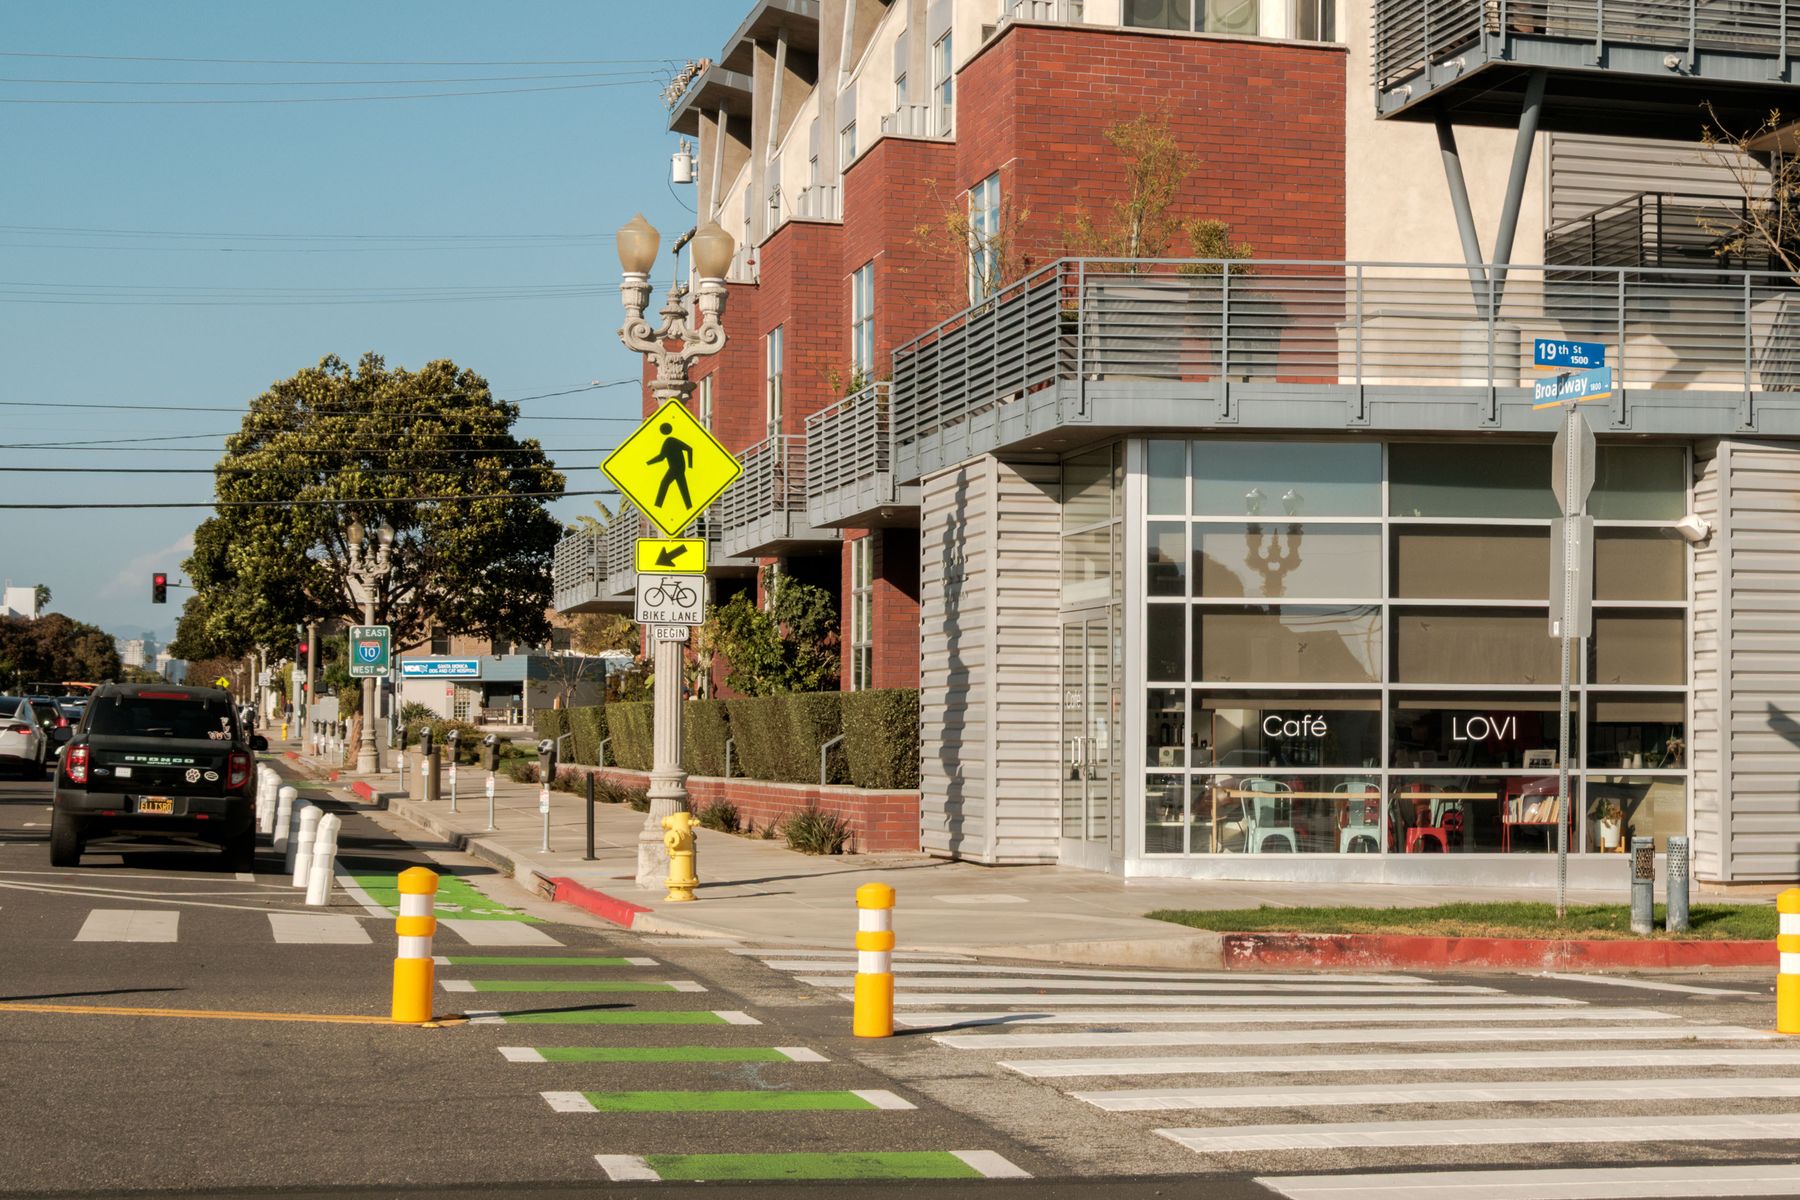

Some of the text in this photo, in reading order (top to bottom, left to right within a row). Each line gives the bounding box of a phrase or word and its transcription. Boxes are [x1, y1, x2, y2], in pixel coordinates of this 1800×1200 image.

[1539, 343, 1582, 360] 19th St
[1571, 356, 1589, 365] 1500
[1535, 377, 1588, 400] Broadway
[642, 611, 697, 622] BIKE LANE
[365, 629, 387, 637] EAST
[657, 629, 685, 638] BEGIN
[364, 647, 376, 658] 10
[352, 666, 375, 674] WEST
[1263, 714, 1327, 737] Café
[1453, 716, 1516, 740] LOVI
[125, 755, 195, 764] BRONCO
